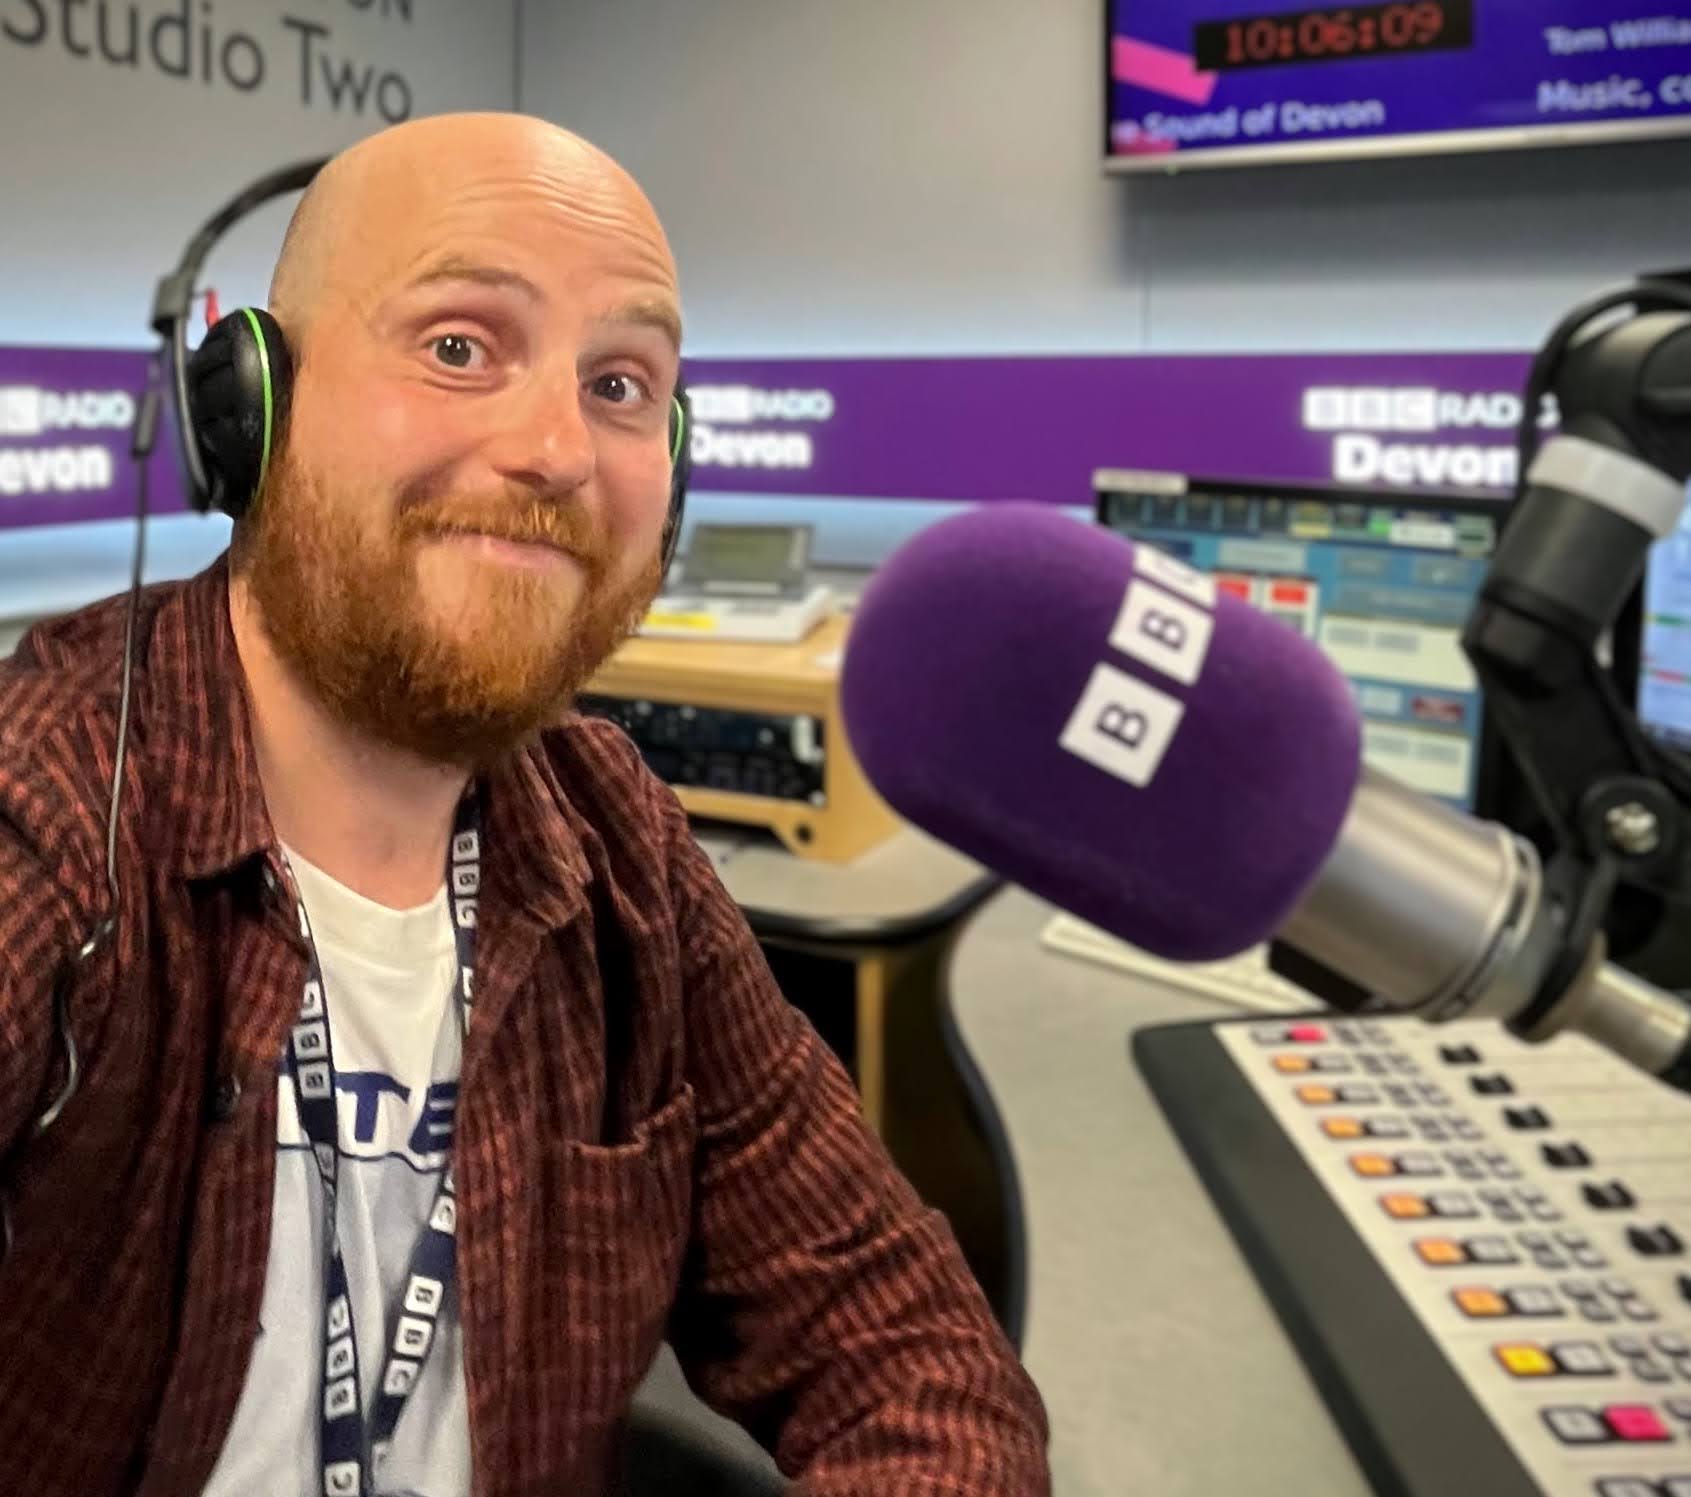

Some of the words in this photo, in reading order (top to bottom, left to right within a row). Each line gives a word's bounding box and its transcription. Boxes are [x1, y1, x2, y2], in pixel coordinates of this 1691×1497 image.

[1226, 2, 1444, 63] 10:06:09
[281, 16, 413, 125] Two
[1144, 105, 1239, 142] Sound
[1241, 102, 1278, 137] of
[1280, 99, 1386, 133] Devon
